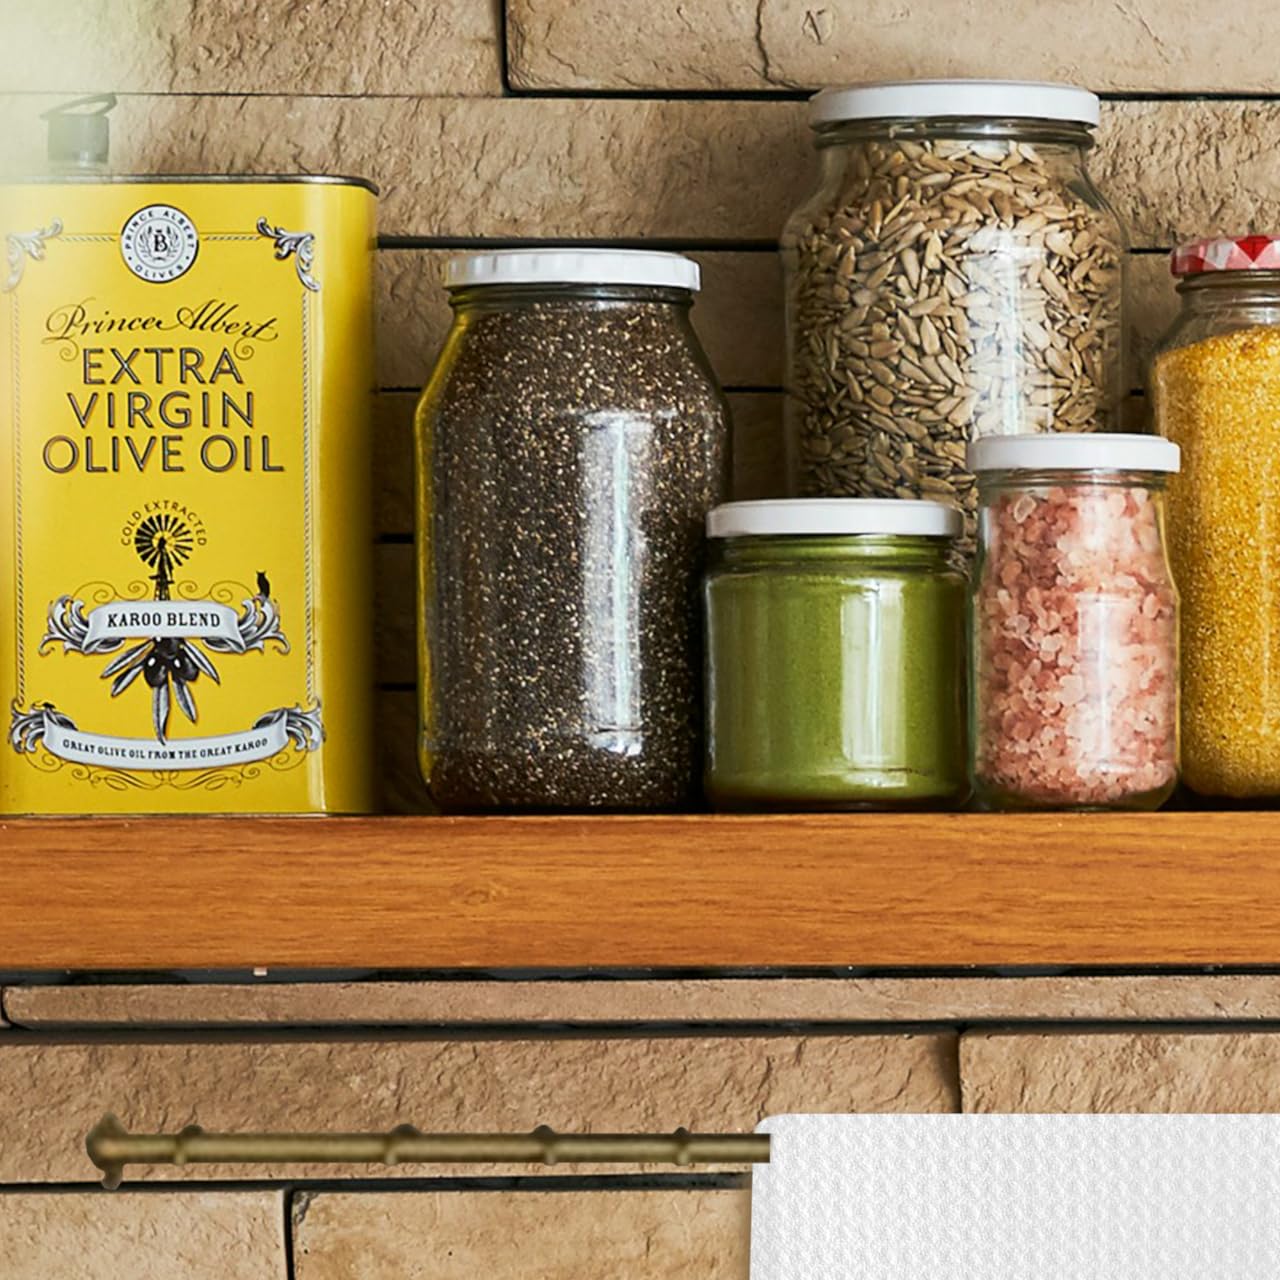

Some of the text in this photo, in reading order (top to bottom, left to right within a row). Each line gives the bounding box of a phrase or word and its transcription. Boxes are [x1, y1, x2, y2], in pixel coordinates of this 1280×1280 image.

[124, 210, 195, 250] PRINCE ALBERT
[135, 263, 183, 279] OLIVES
[42, 298, 279, 347] Prince Albert
[82, 347, 243, 385] EXTRA
[67, 391, 254, 429] VIRGIN
[42, 434, 284, 474] OLIVE OIL
[121, 499, 207, 546] COLD EXTRACTED
[107, 612, 221, 628] KAROO BLEND
[62, 737, 269, 760] GREAT OLIVE OIL FROM THE GREAT KAROO
